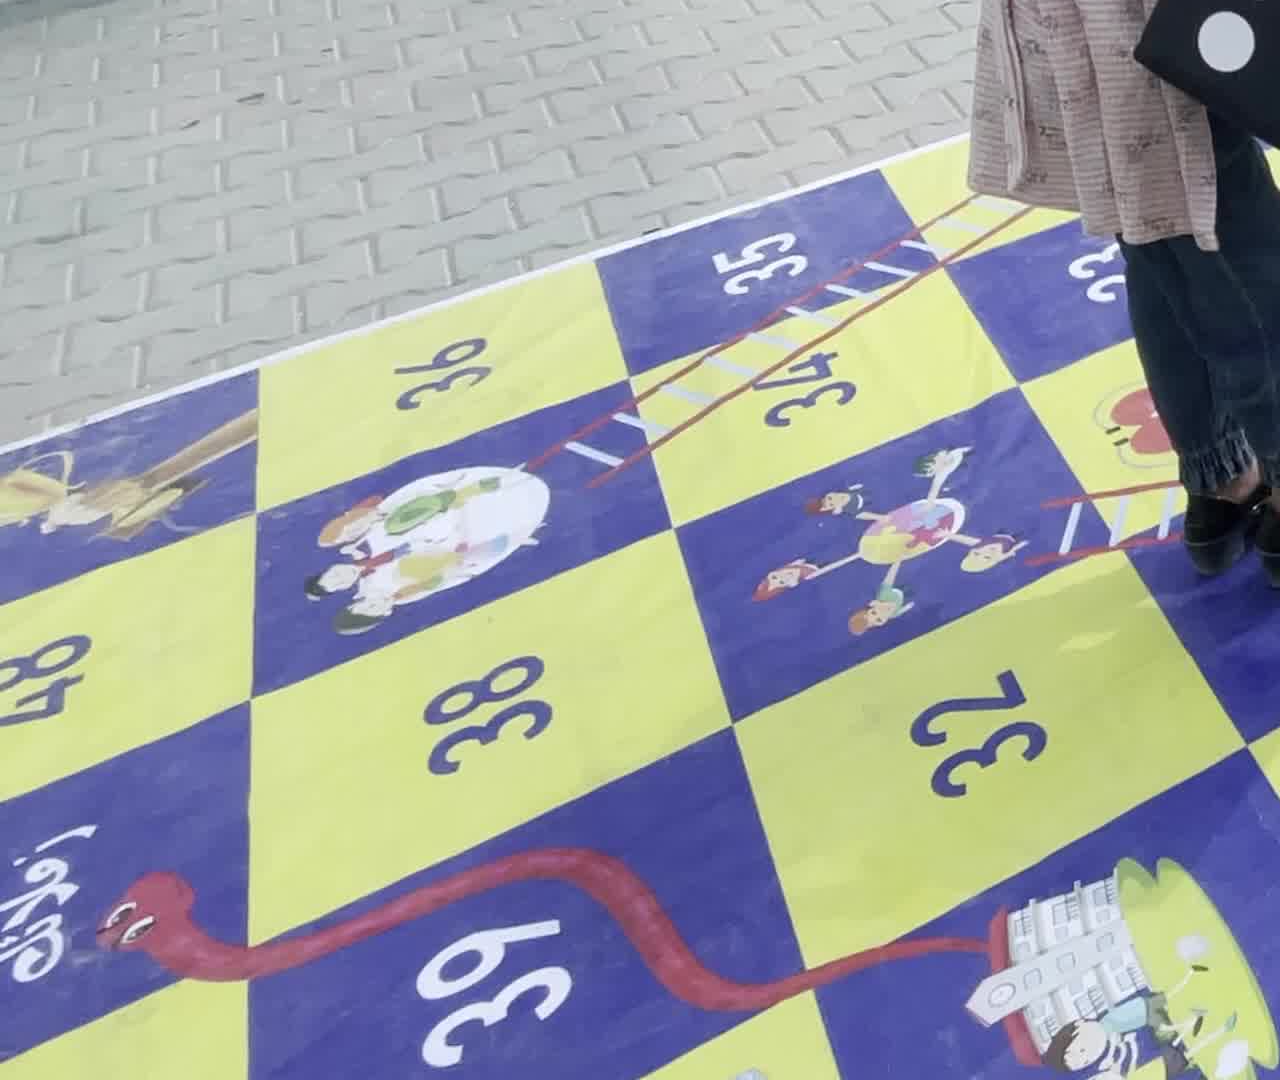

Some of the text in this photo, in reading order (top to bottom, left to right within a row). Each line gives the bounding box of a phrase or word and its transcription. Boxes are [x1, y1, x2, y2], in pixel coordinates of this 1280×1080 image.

[712, 232, 797, 296] 35
[395, 336, 489, 412] 36
[752, 351, 858, 428] 34
[0, 634, 92, 728] 48
[422, 655, 554, 776] 38
[909, 669, 1048, 800] 32
[416, 918, 573, 1069] 39
